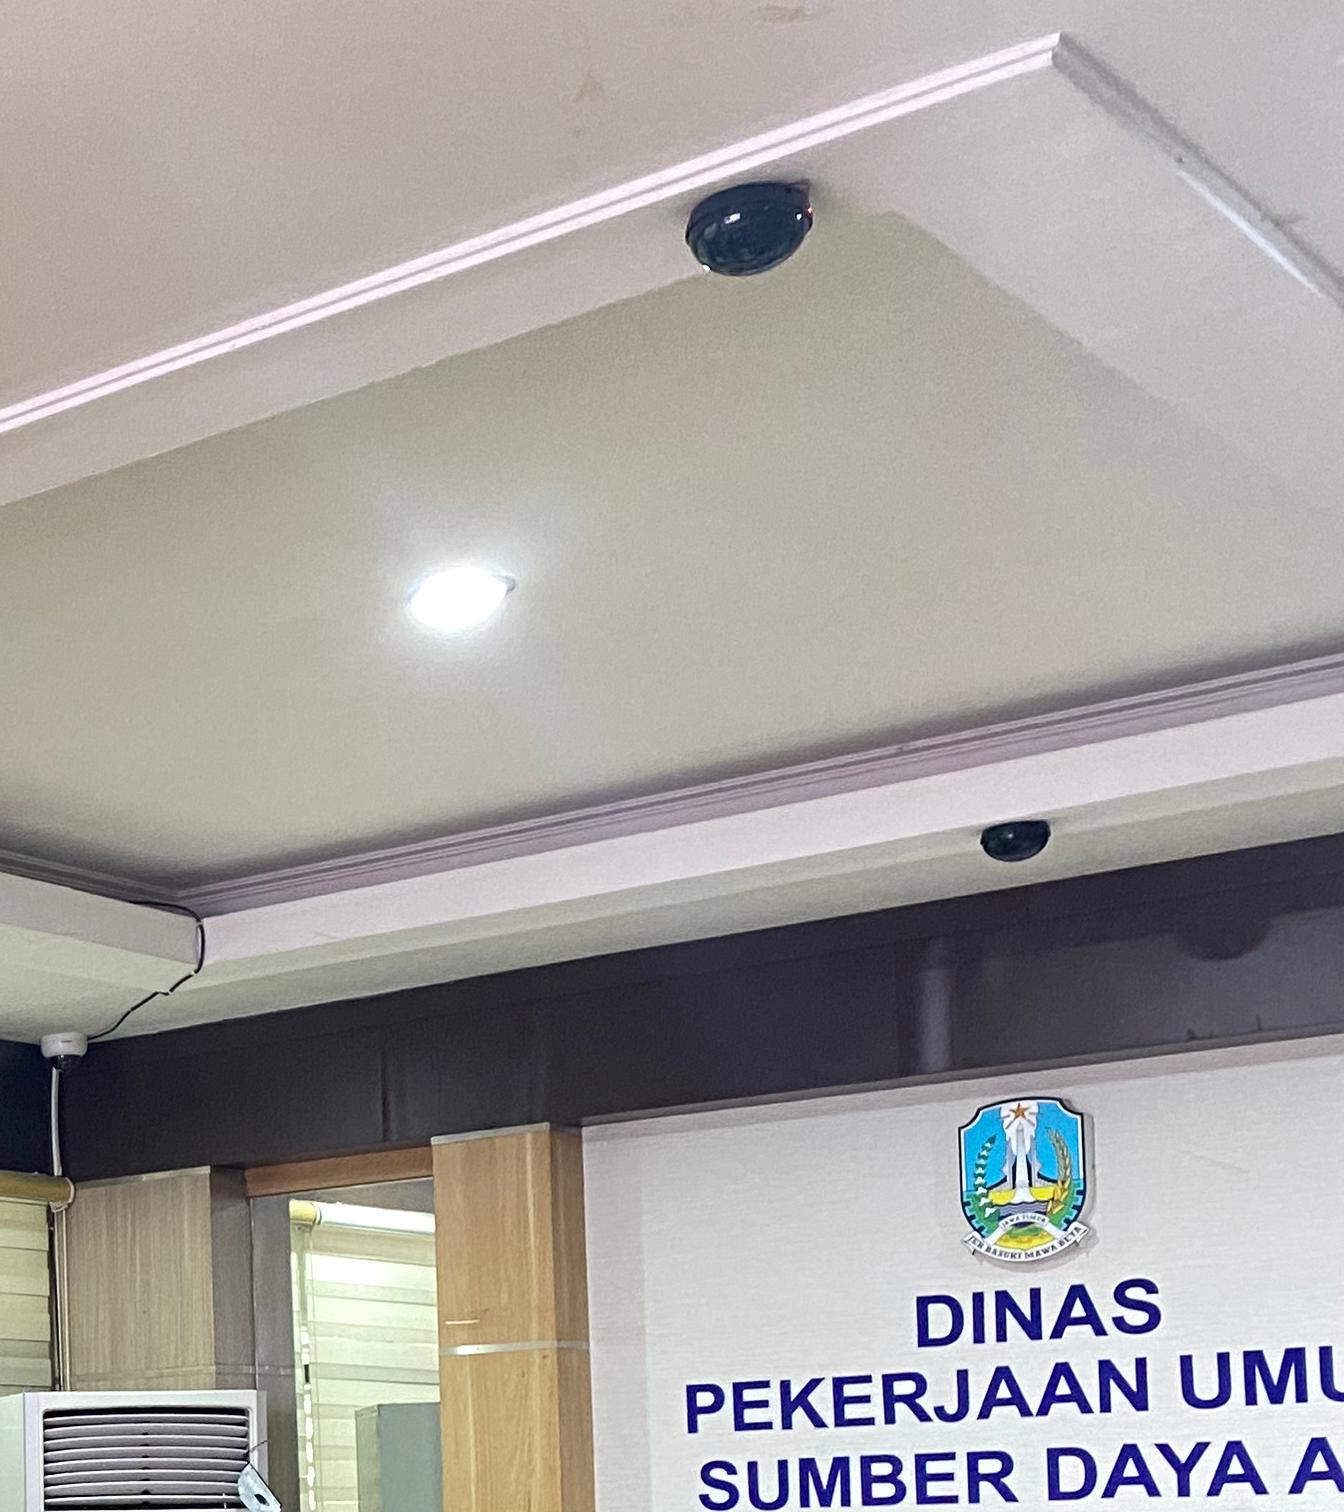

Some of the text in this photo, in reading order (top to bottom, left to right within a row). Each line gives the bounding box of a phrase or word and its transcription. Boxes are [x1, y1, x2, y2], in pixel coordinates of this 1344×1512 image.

[915, 1278, 1162, 1348] DINAS
[685, 1356, 1150, 1434] PEKERJAAN
[698, 1448, 1019, 1512] SUMBER
[1047, 1439, 1269, 1502] DAYA
